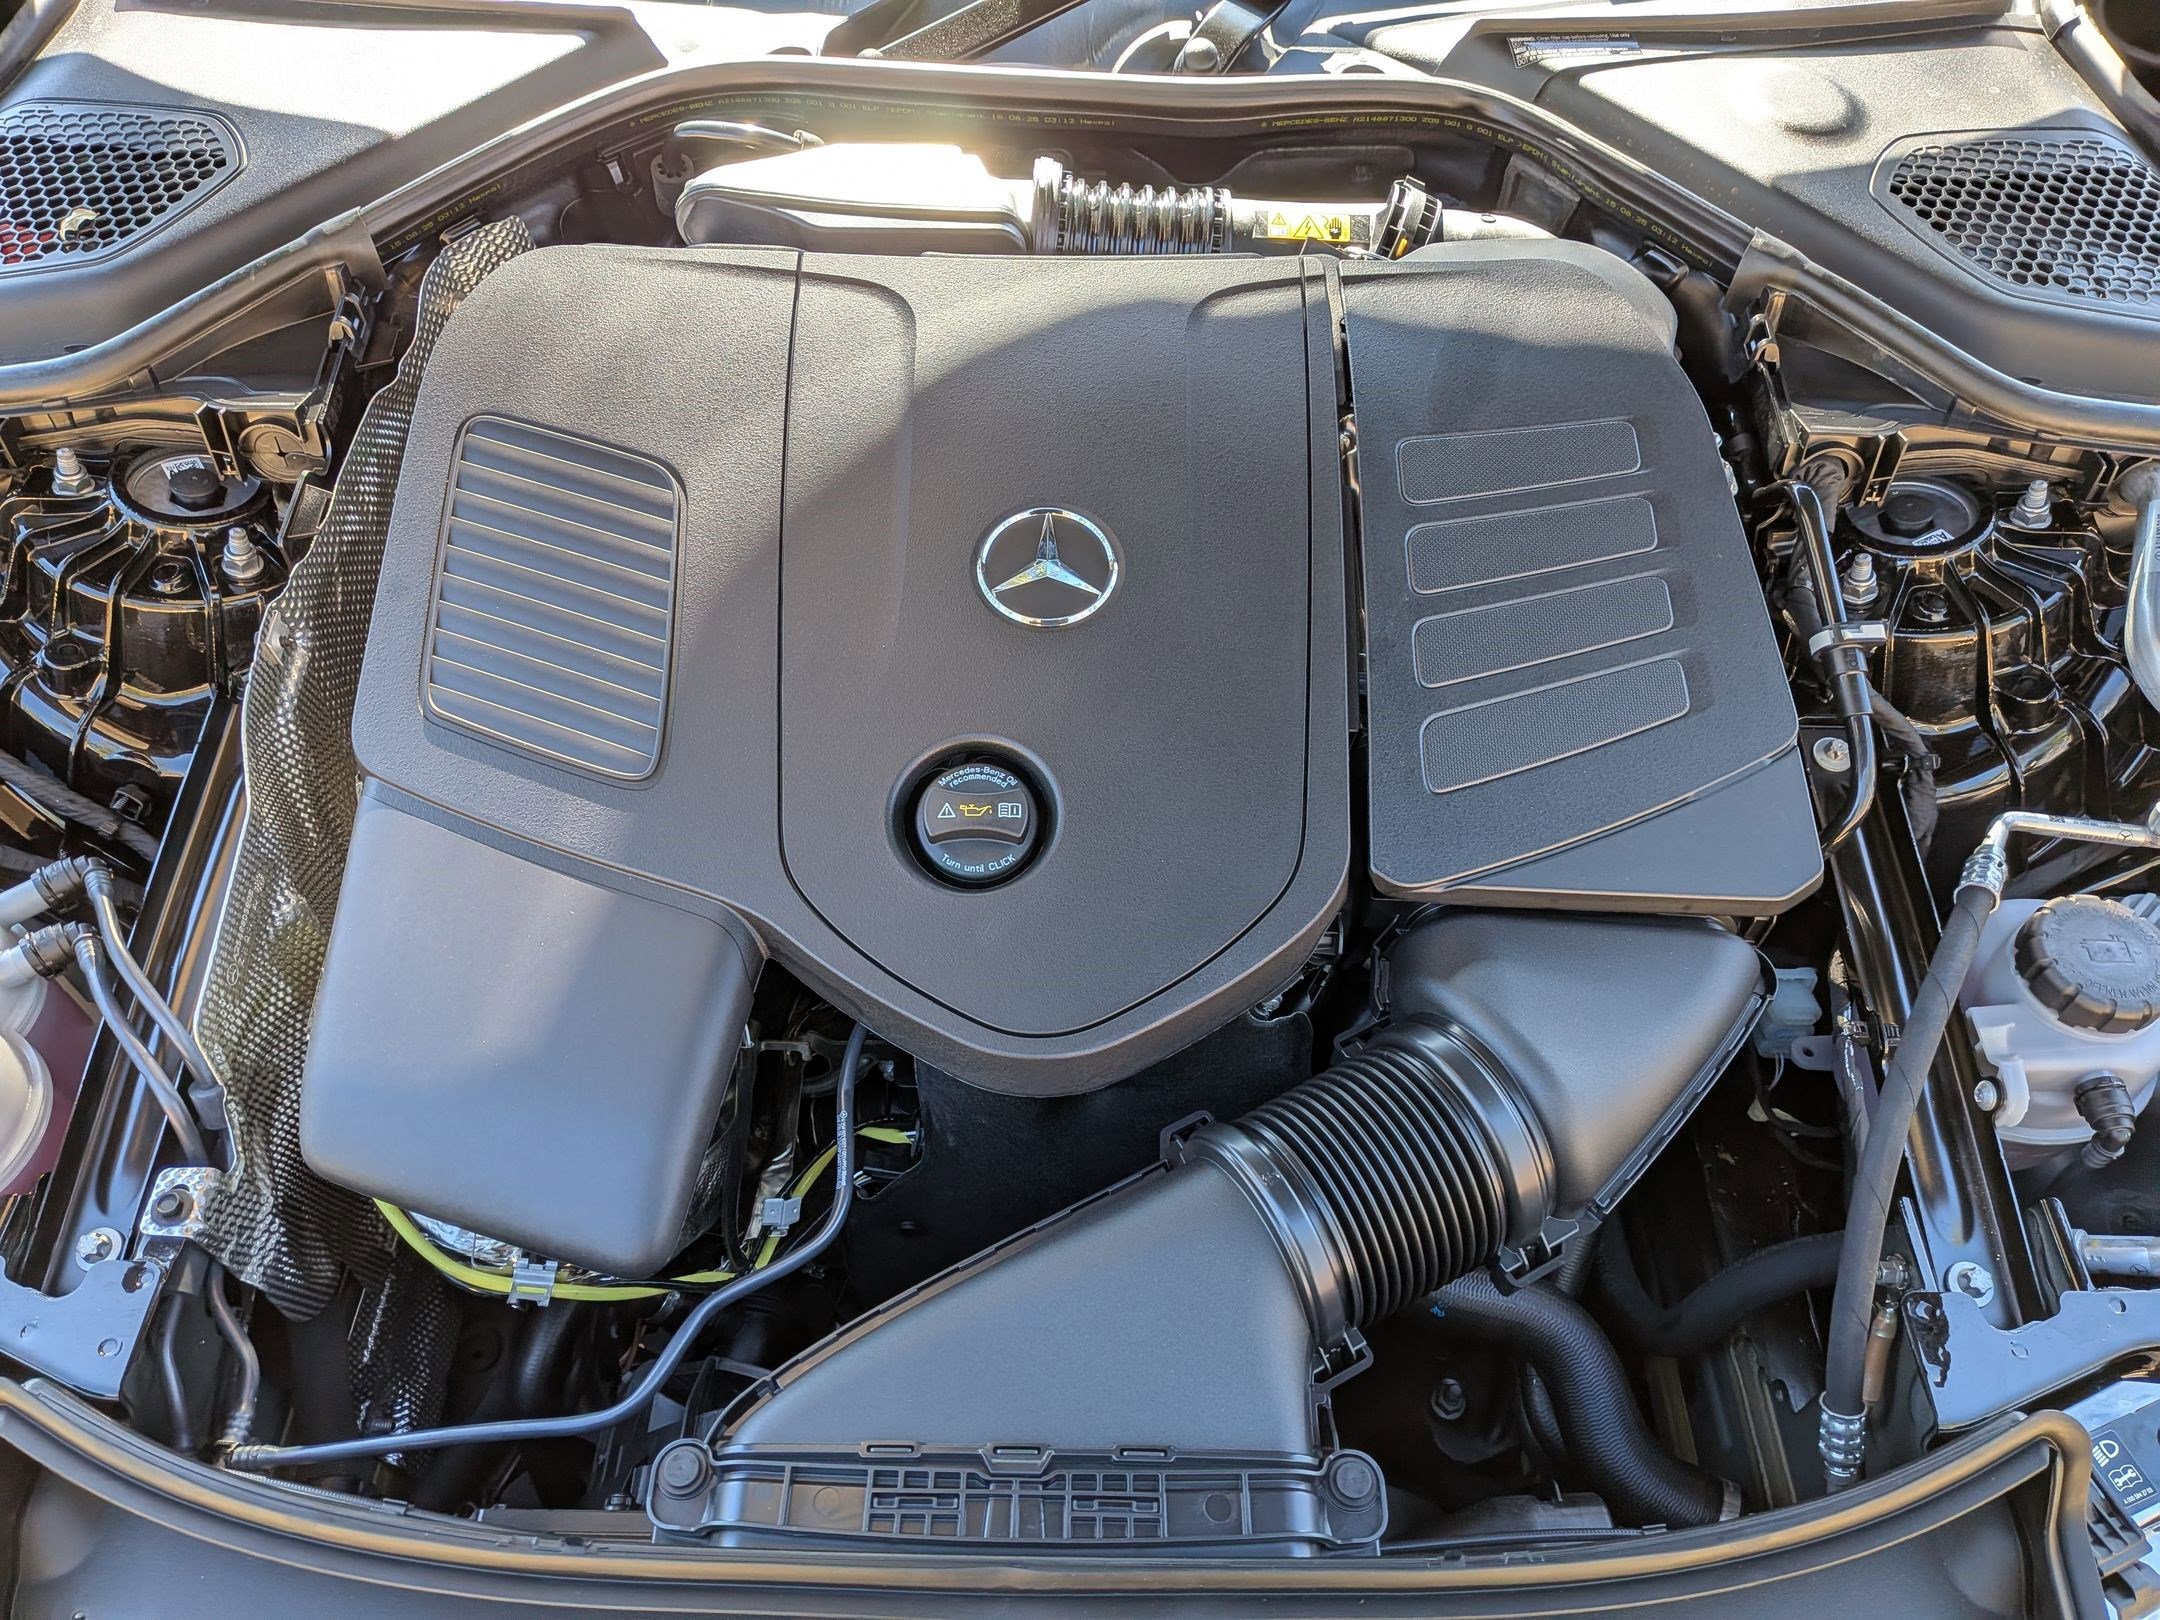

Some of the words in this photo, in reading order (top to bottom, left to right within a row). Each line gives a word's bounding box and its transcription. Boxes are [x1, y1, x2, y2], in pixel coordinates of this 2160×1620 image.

[1272, 115, 1348, 127] MERCEDES-BENZ
[1444, 119, 1461, 128] 001
[1477, 126, 1492, 137] 001
[1651, 224, 1679, 245] 03:12
[437, 202, 466, 222] 03:12
[937, 766, 1006, 788] Mercedes-Benz
[1006, 775, 1018, 788] Oil
[948, 773, 1010, 789] recommended
[941, 853, 962, 869] Turn
[964, 864, 985, 873] until
[988, 853, 1016, 872] CLICK
